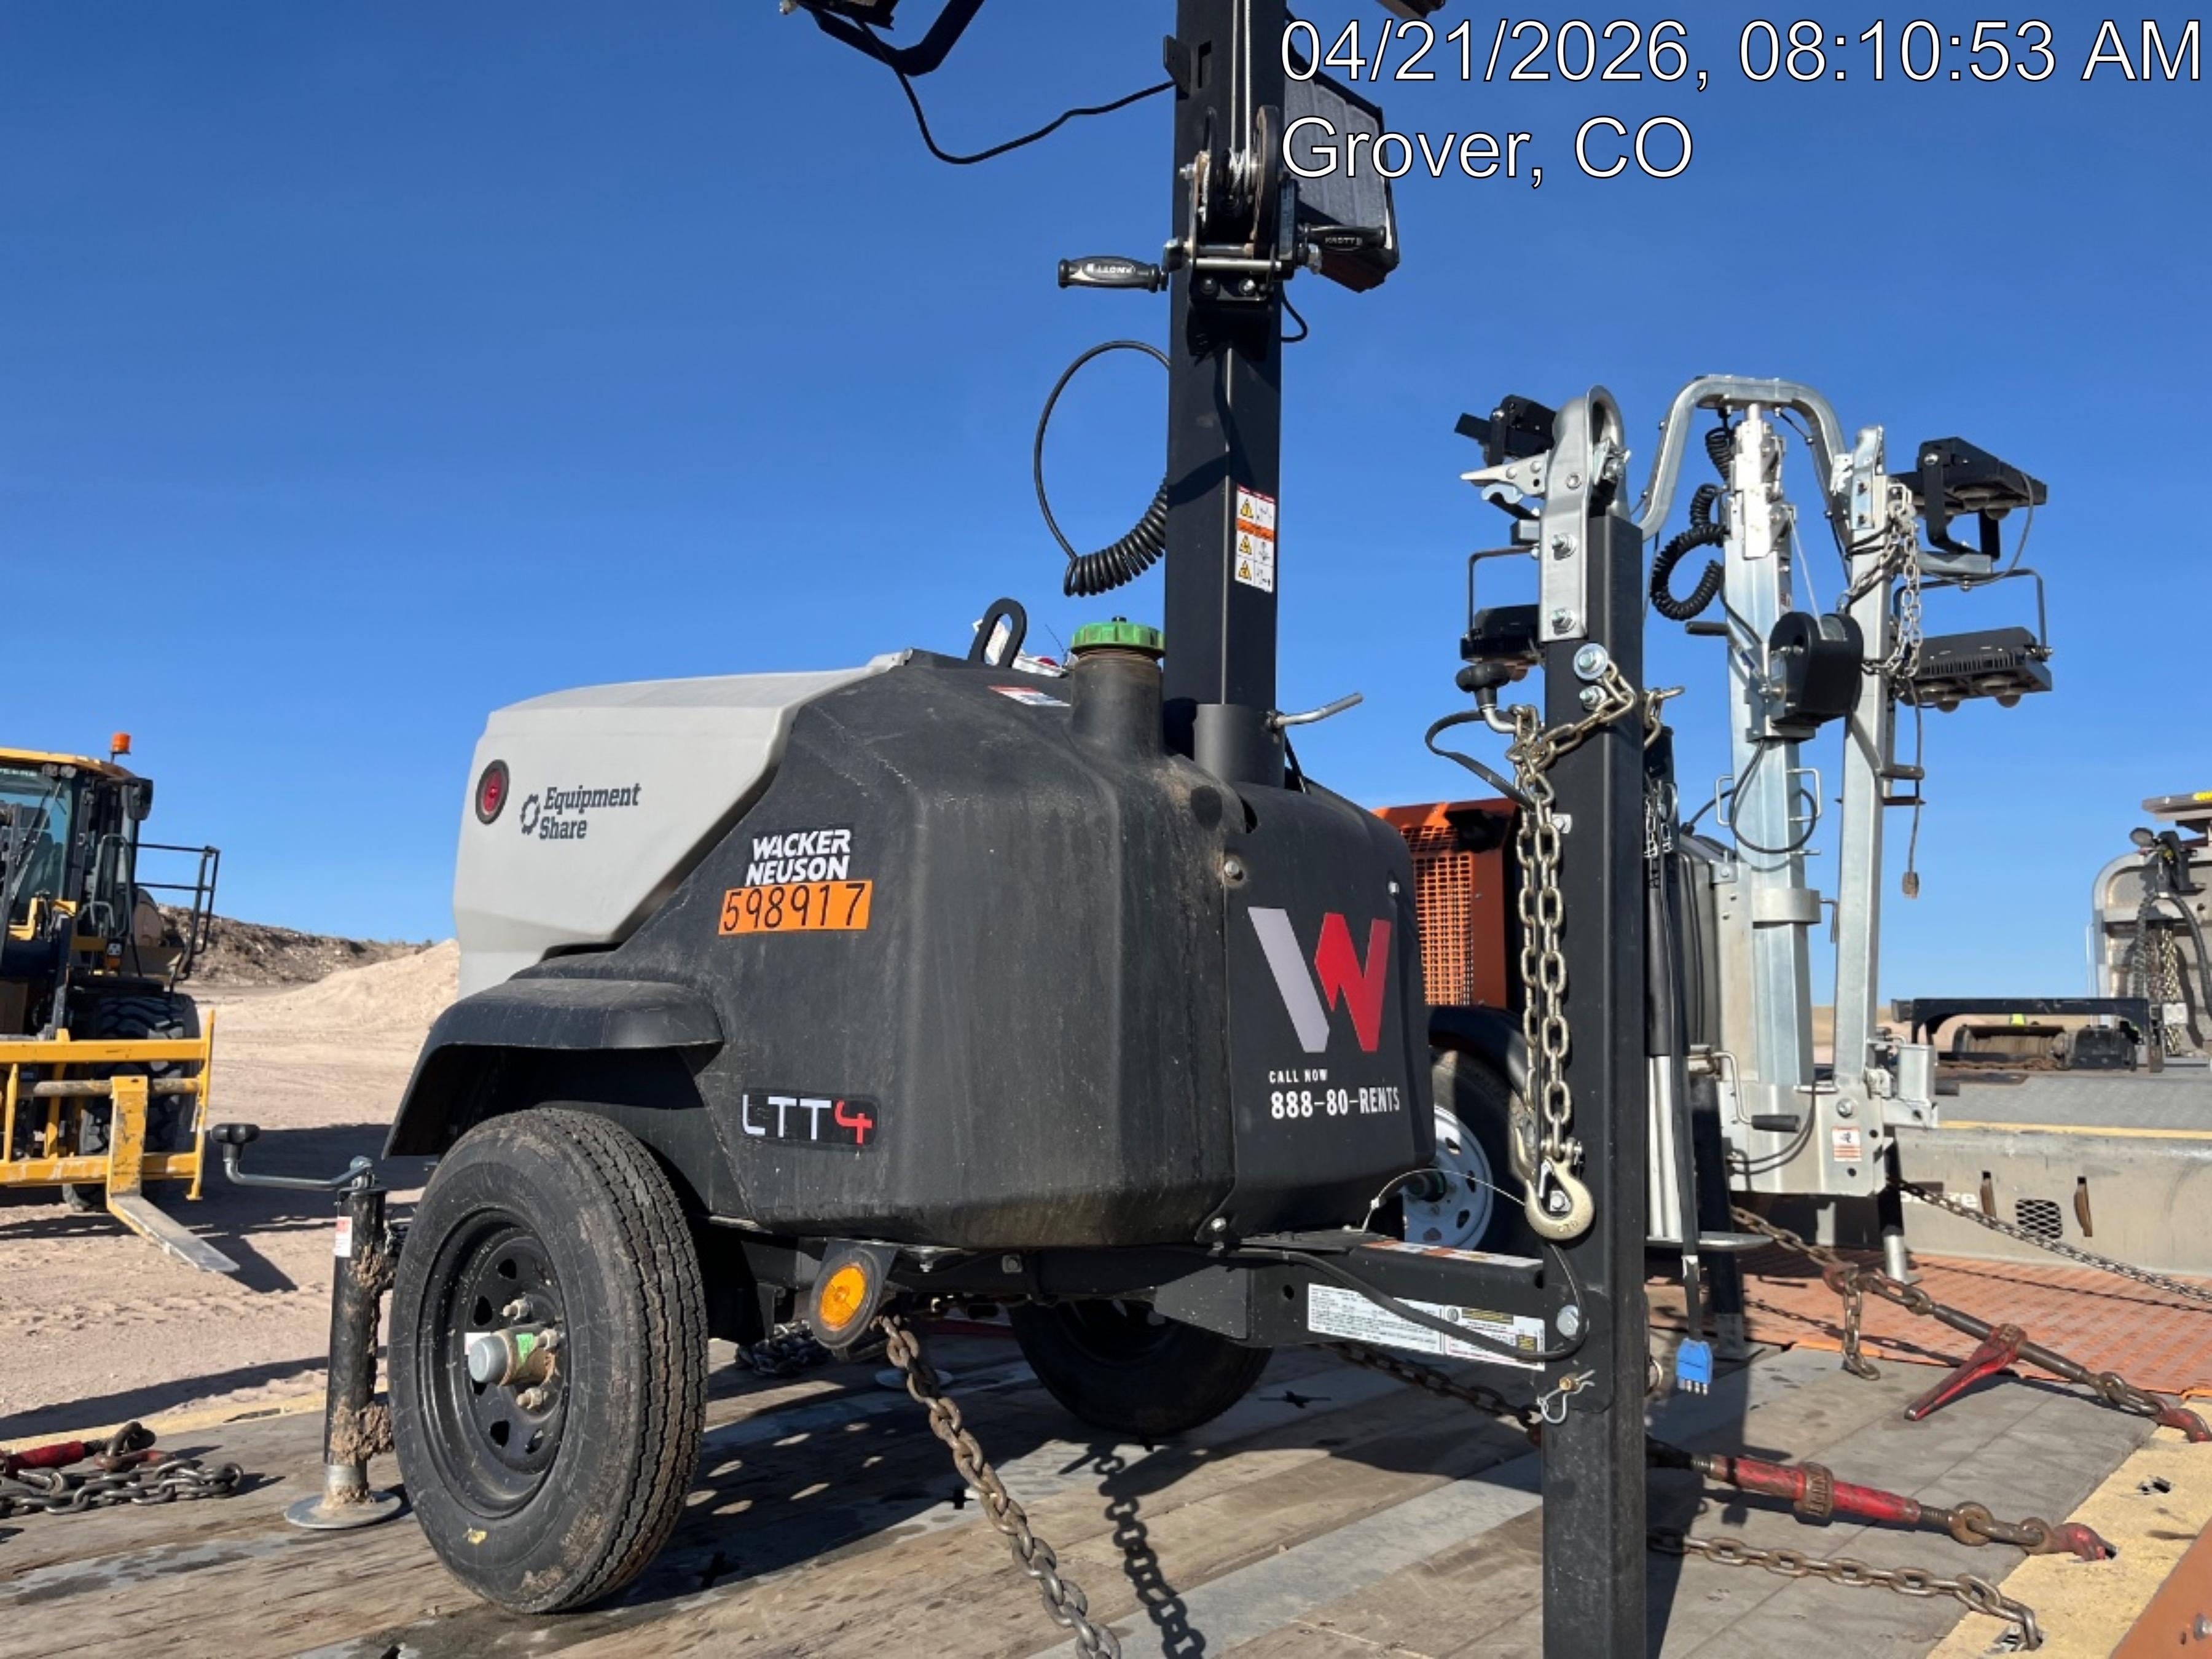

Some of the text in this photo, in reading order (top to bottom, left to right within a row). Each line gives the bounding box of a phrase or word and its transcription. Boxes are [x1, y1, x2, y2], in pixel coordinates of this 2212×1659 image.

[544, 783, 641, 815] Equipment
[539, 816, 587, 839] Share
[752, 829, 852, 861] WACKER
[744, 855, 850, 887] NEUSON
[724, 883, 866, 931] 598917
[1269, 1069, 1328, 1083] CALL NOW
[1270, 1086, 1401, 1119] 888-80-RENTS
[742, 1094, 873, 1144] LTT4
